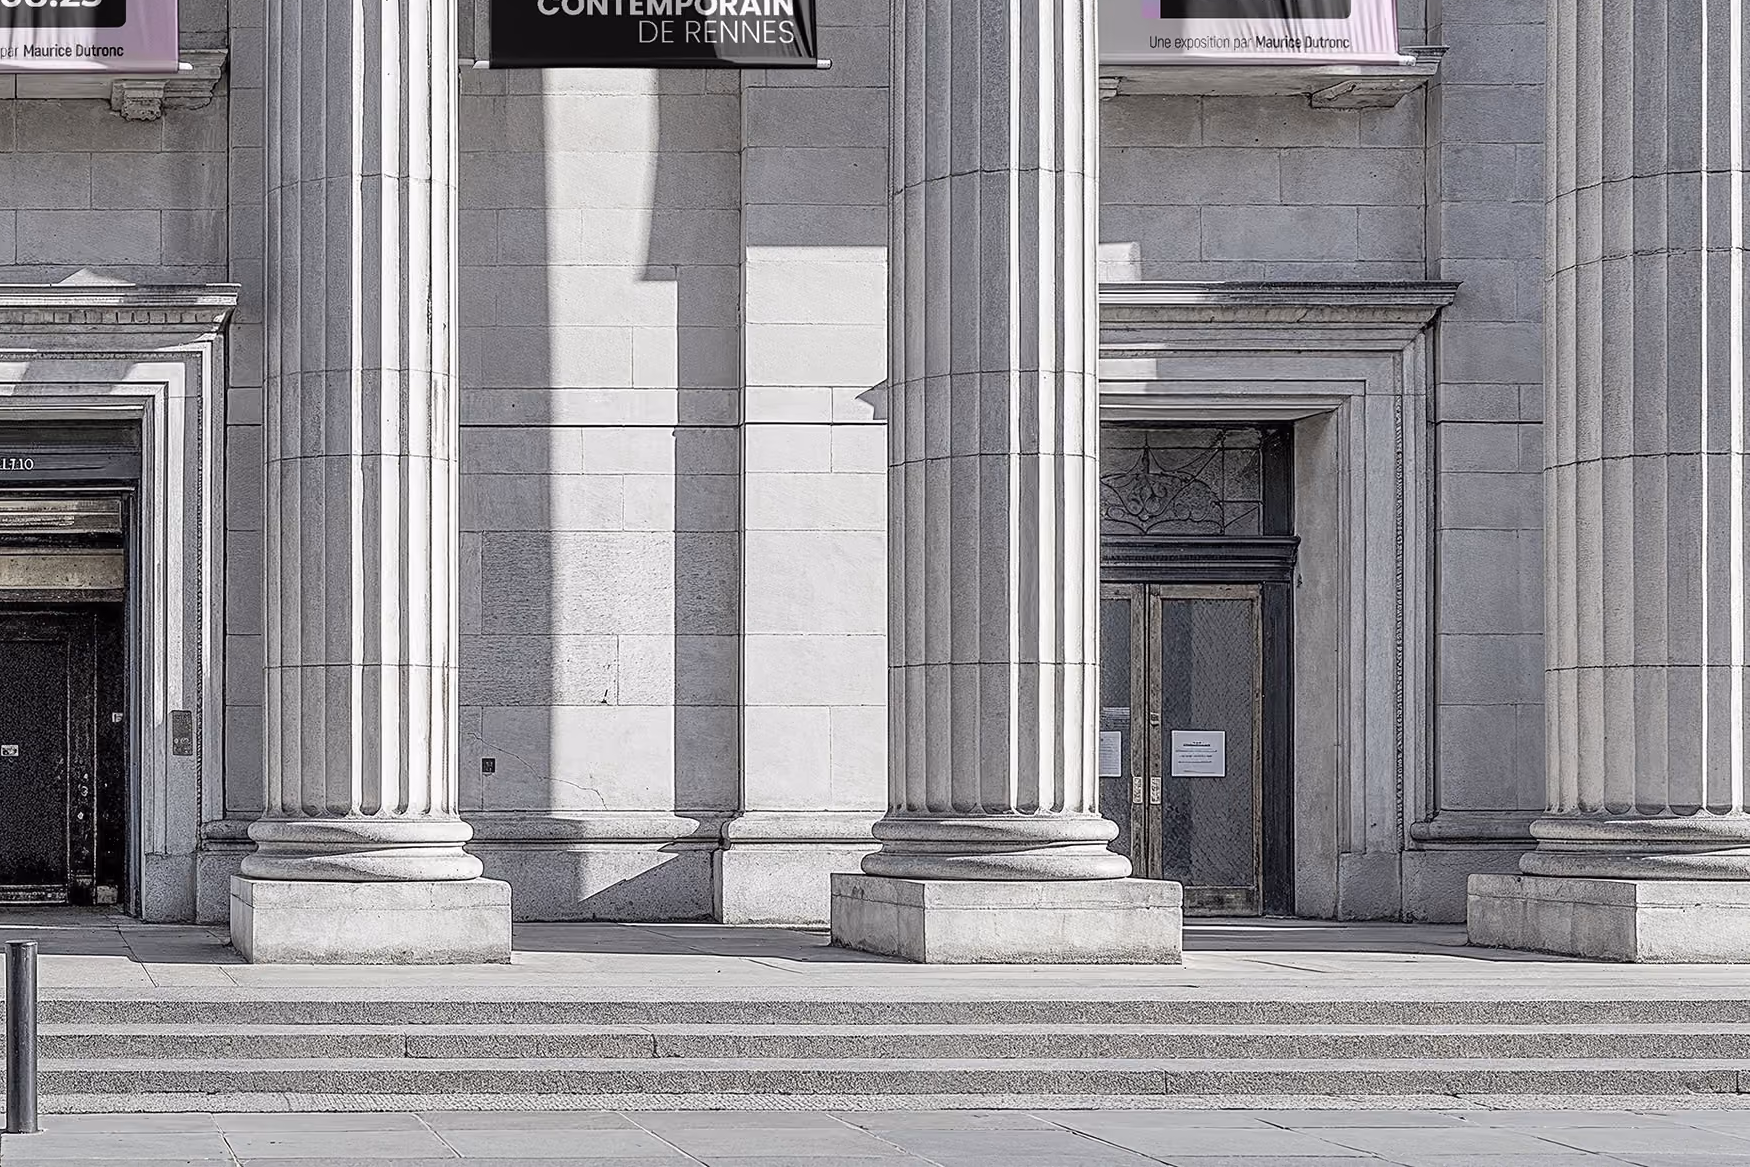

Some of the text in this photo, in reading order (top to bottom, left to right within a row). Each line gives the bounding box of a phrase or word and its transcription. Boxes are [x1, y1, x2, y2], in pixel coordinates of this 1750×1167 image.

[638, 20, 794, 43] DE RENNES
[1149, 35, 1350, 50] Une exposition par Maurice Dutronc
[0, 46, 19, 60] par
[23, 44, 72, 58] Maurice
[75, 44, 124, 57] Dutronc
